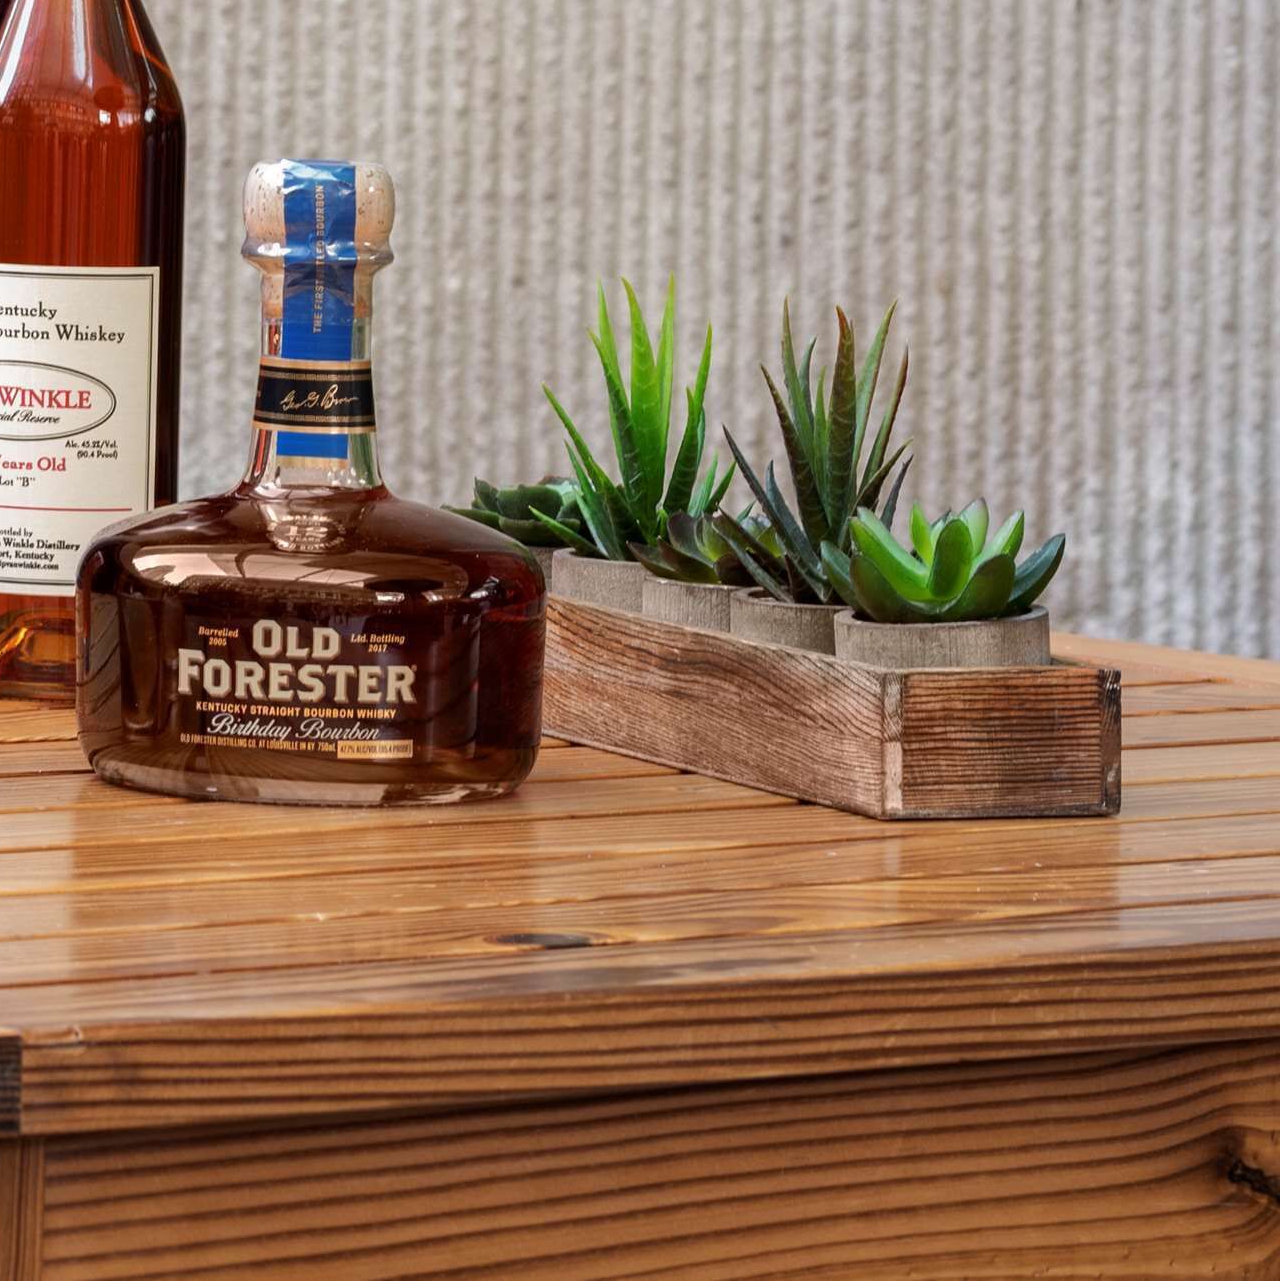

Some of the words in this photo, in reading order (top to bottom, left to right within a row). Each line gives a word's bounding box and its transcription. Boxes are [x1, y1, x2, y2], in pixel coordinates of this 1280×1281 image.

[314, 185, 325, 236] BOURBON
[313, 280, 324, 310] FIRST
[312, 314, 323, 333] THE
[55, 324, 126, 344] Whiskey
[17, 410, 62, 424] Reserve
[37, 456, 67, 472] Old
[16, 476, 36, 487] "B"
[24, 527, 33, 538] by
[3, 537, 35, 549] Winkle
[37, 540, 81, 551] Distillery
[15, 550, 55, 562] Kentucky
[198, 626, 239, 639] Barrelled
[252, 618, 341, 661] OLD
[350, 633, 369, 644] Ltd.
[369, 633, 406, 645] Bottling
[368, 644, 387, 653] 2017
[177, 648, 418, 705] FORESTER
[196, 701, 247, 715] KENTUCKY
[250, 704, 301, 717] STRAIGHT
[303, 707, 354, 719] BOURBON
[357, 709, 397, 720] WHISKY
[207, 713, 292, 741] Birthday
[295, 718, 380, 740] Bourbon
[180, 733, 191, 743] OLD
[191, 734, 217, 745] FORESTER
[258, 740, 266, 748] AT
